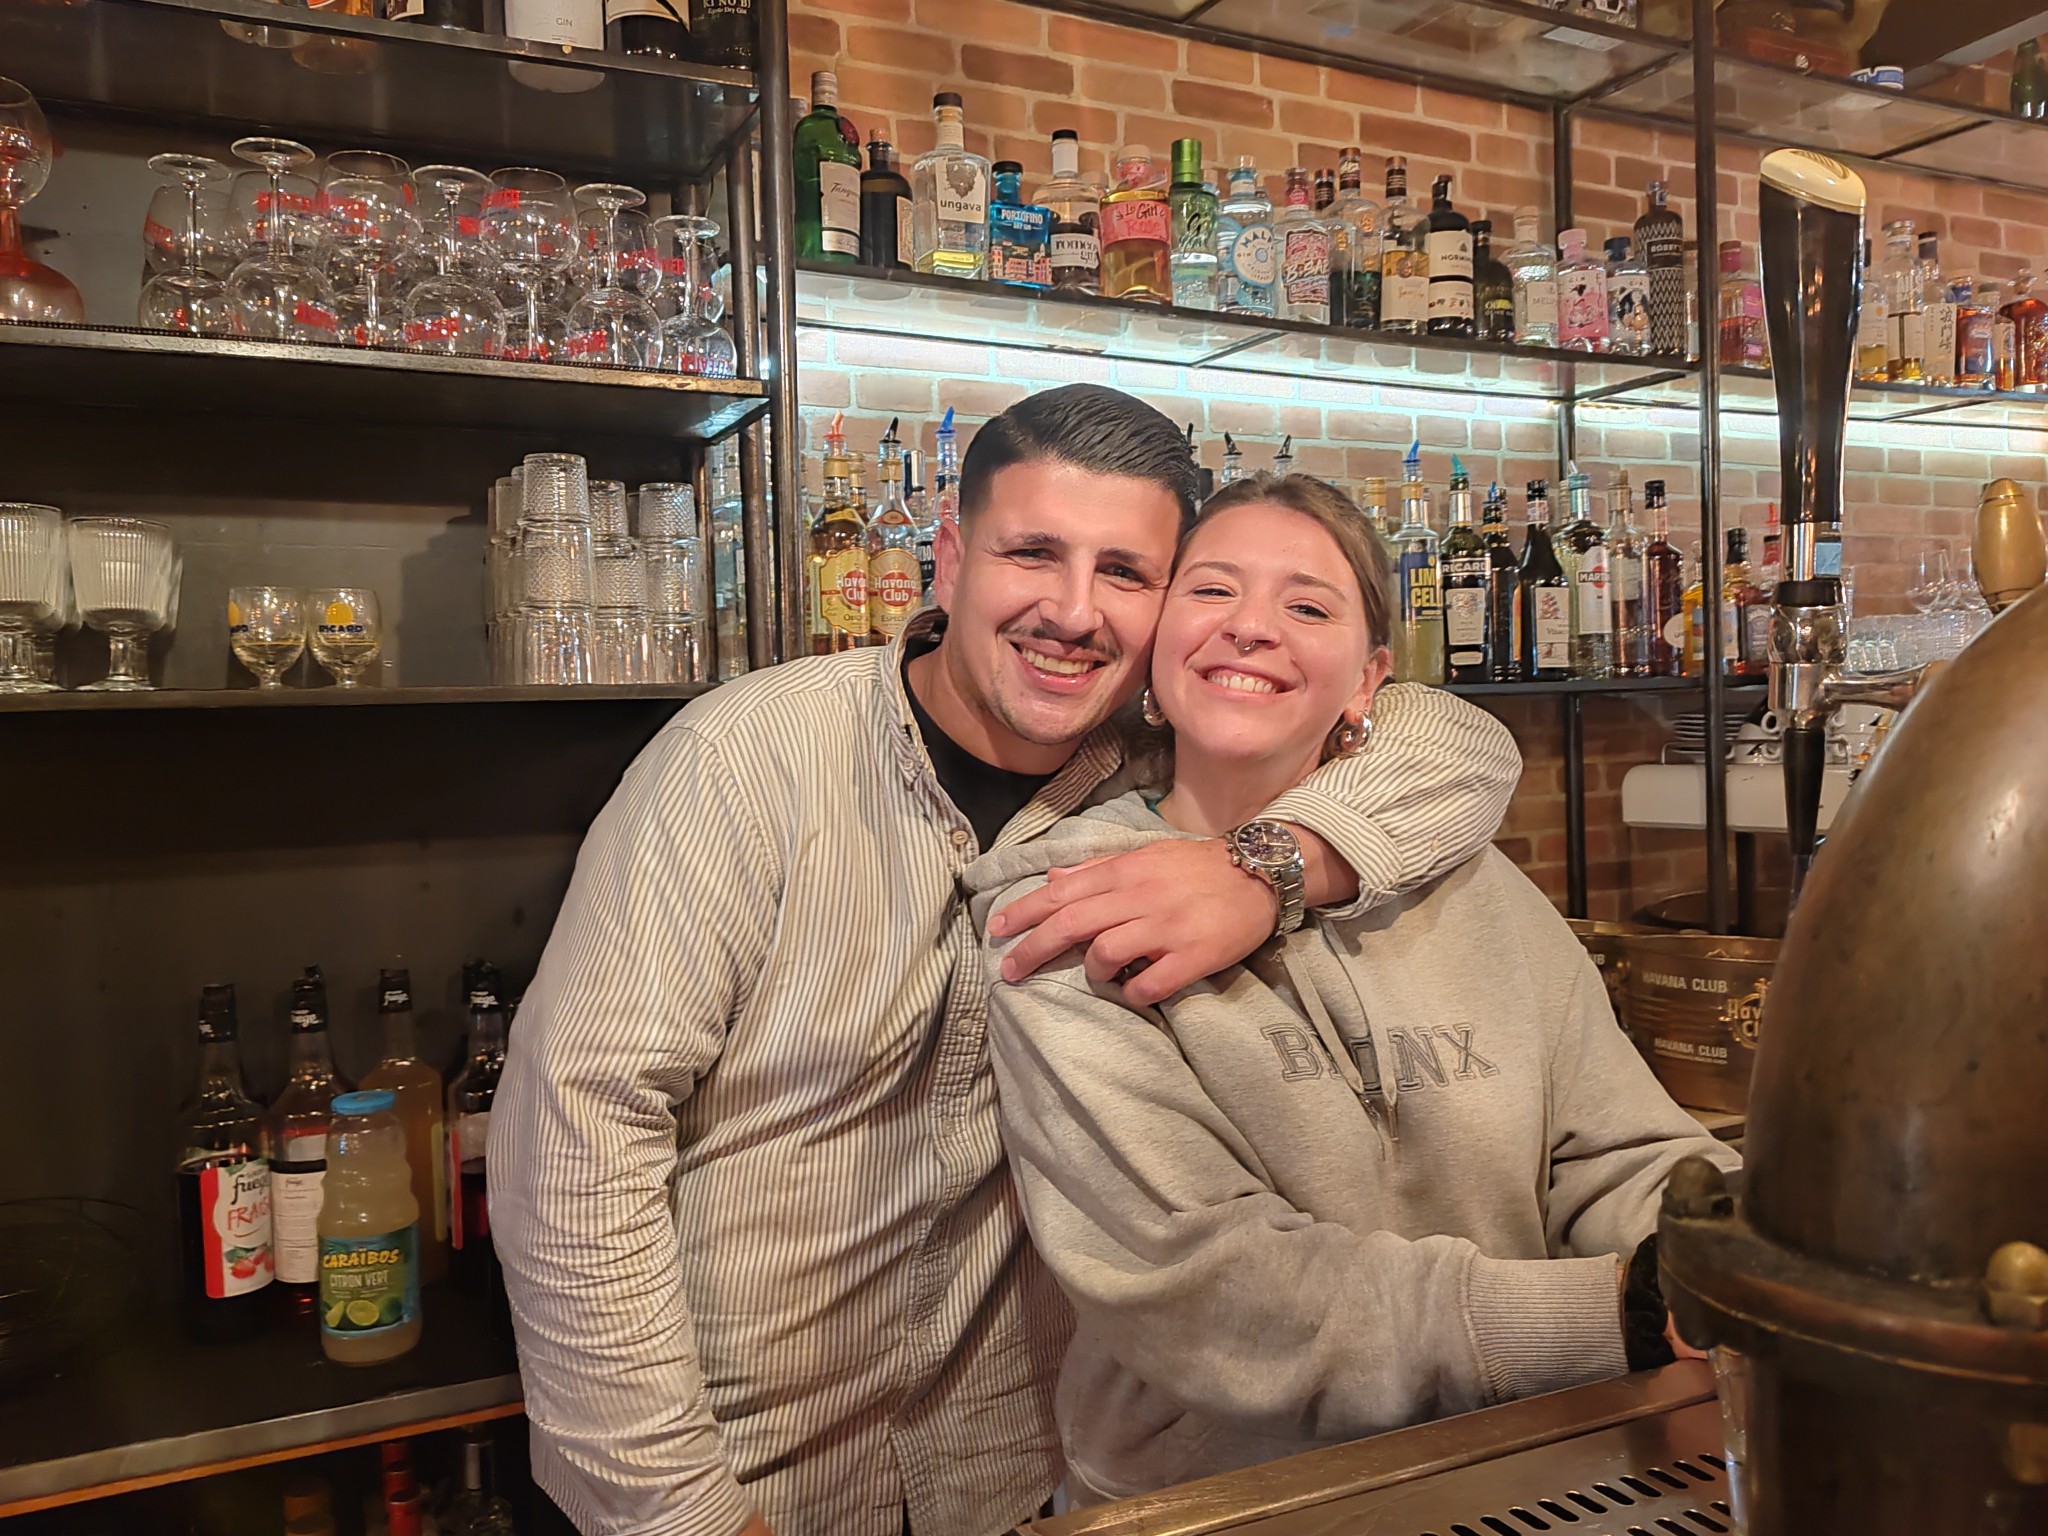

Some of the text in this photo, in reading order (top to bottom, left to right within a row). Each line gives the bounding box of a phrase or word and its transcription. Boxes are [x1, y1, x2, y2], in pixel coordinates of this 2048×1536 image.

[555, 17, 573, 28] GIN
[940, 200, 981, 212] ungava
[883, 589, 909, 602] Club
[318, 625, 363, 633] RICARD
[1642, 970, 1728, 994] HAVANA CLUB
[1655, 1037, 1695, 1055] HAVANA
[1698, 1044, 1728, 1058] CLUB
